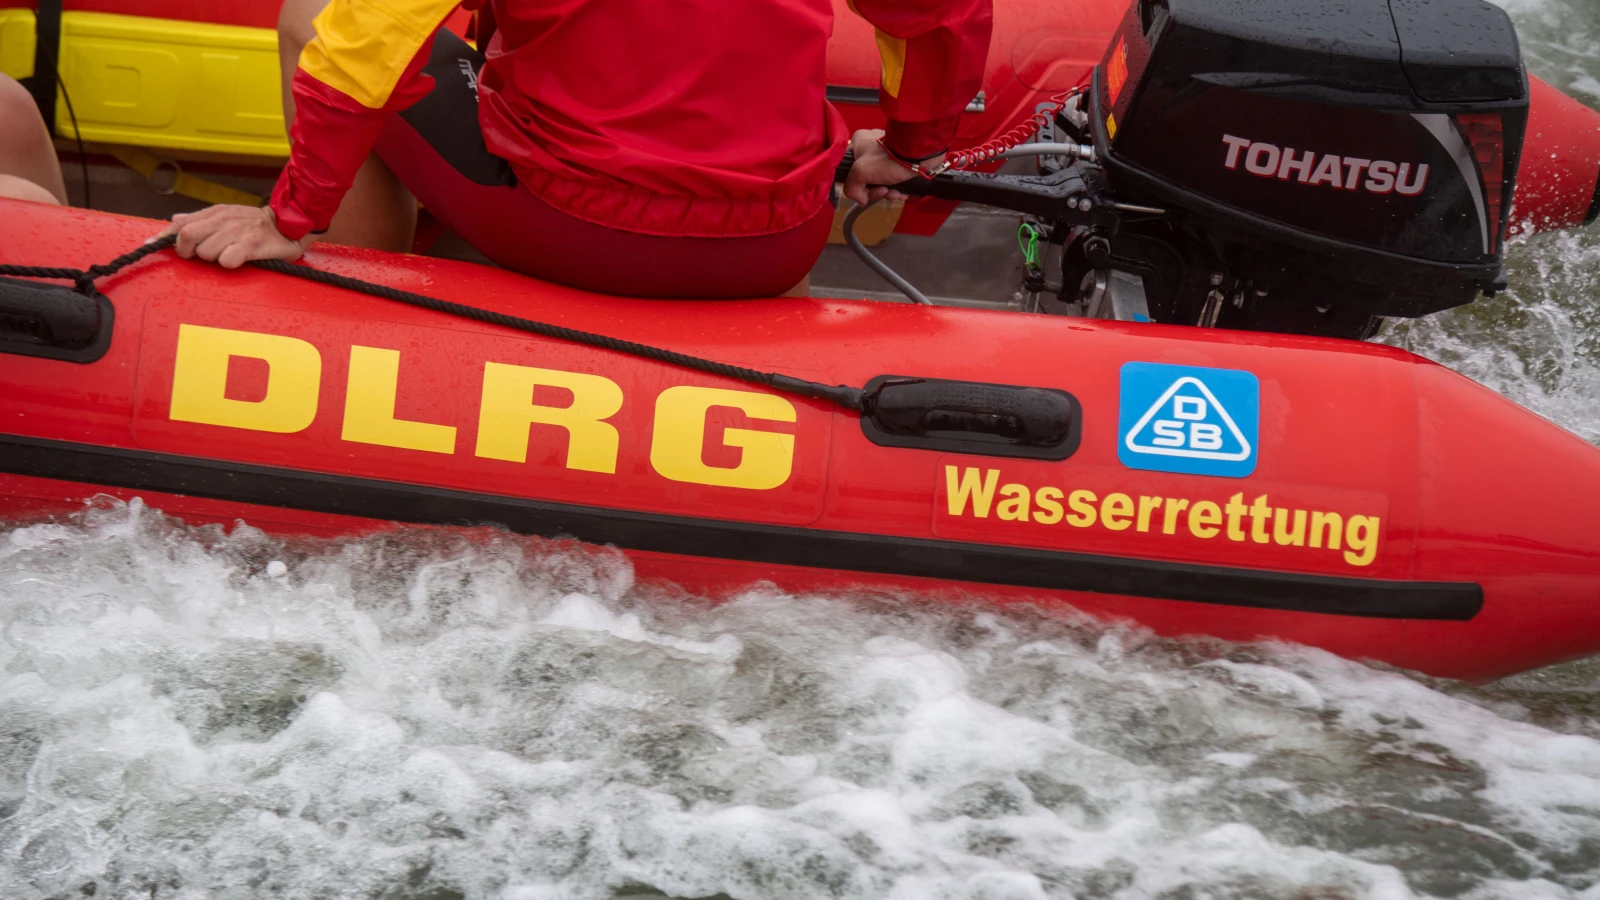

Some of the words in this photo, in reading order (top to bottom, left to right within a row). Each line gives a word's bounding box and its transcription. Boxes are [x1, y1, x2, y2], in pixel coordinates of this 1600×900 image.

[1222, 134, 1429, 197] TOHATSU
[170, 324, 796, 489] DLRG
[946, 466, 1378, 565] Wasserrettung
